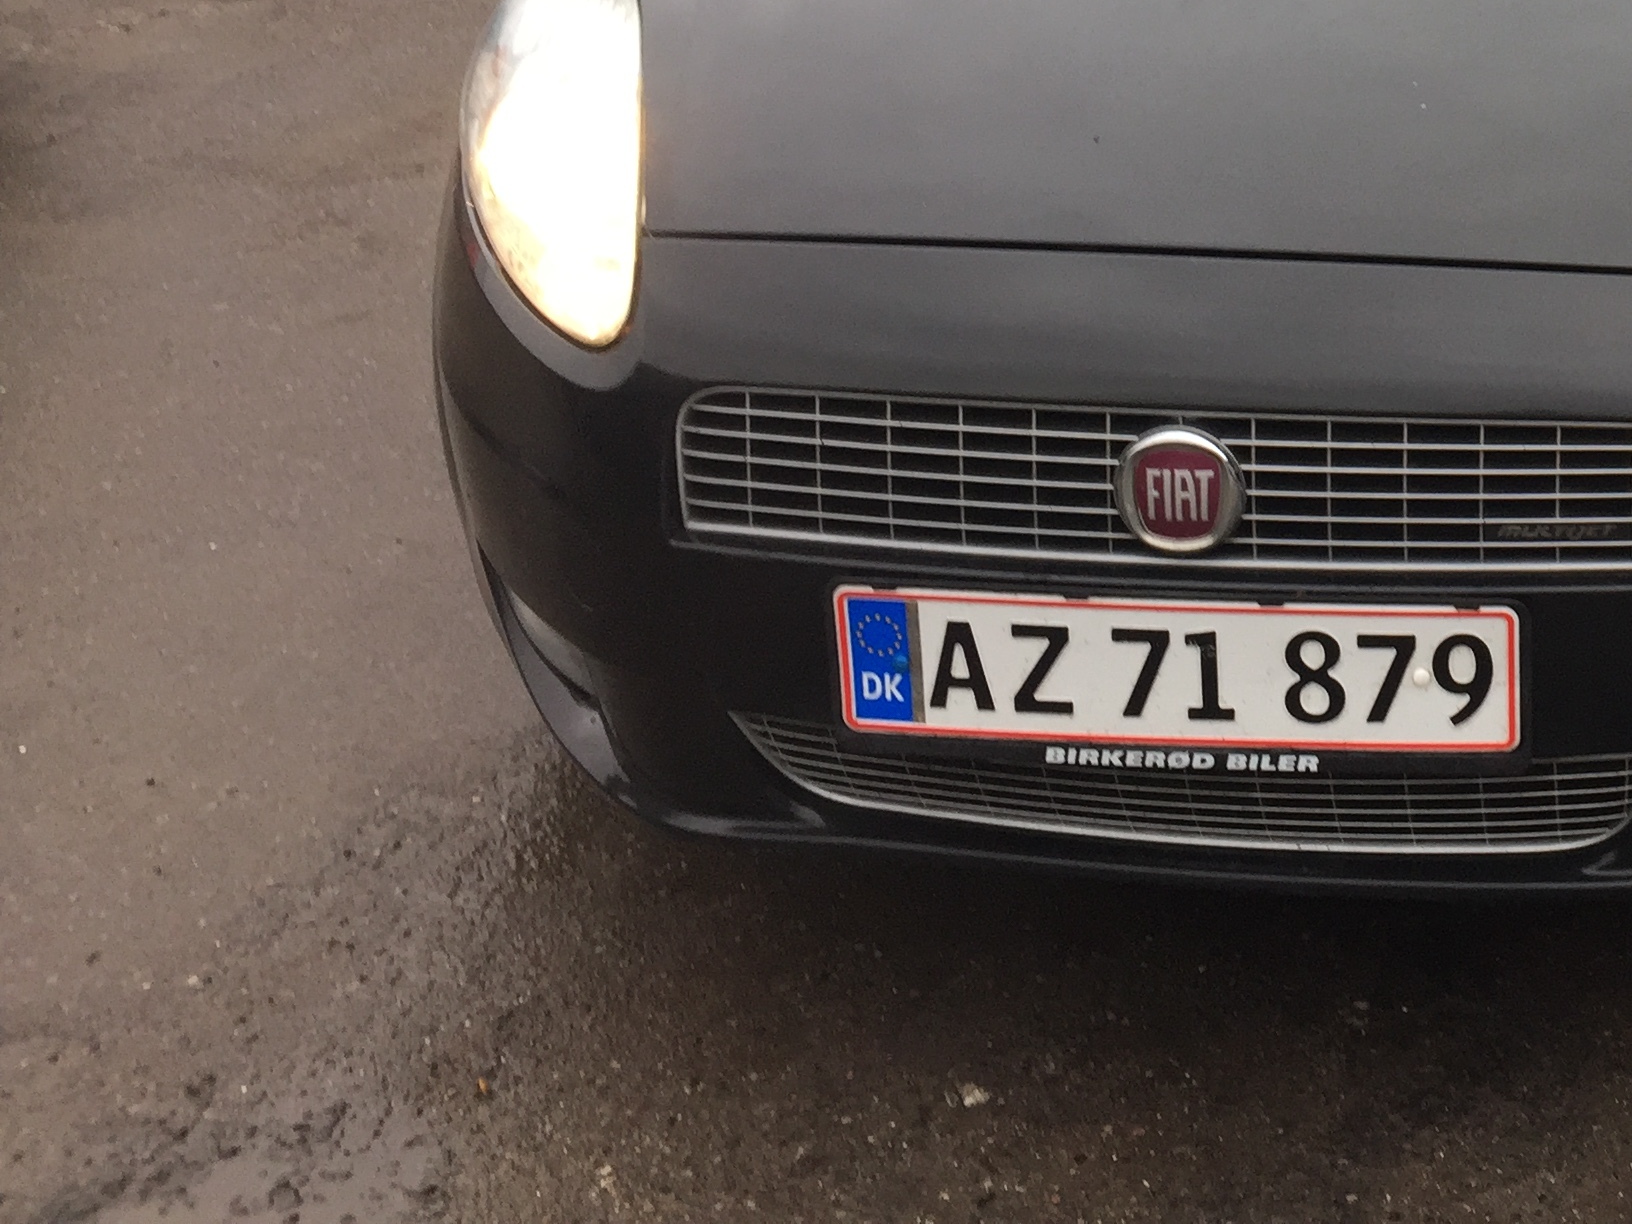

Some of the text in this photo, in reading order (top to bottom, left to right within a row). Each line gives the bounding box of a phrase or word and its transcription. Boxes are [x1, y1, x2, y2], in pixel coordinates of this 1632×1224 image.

[1145, 467, 1214, 523] FIAT
[861, 671, 905, 704] DK
[929, 620, 1494, 727] AZ 71 879
[1045, 746, 1320, 773] BIRKERØD BILER
